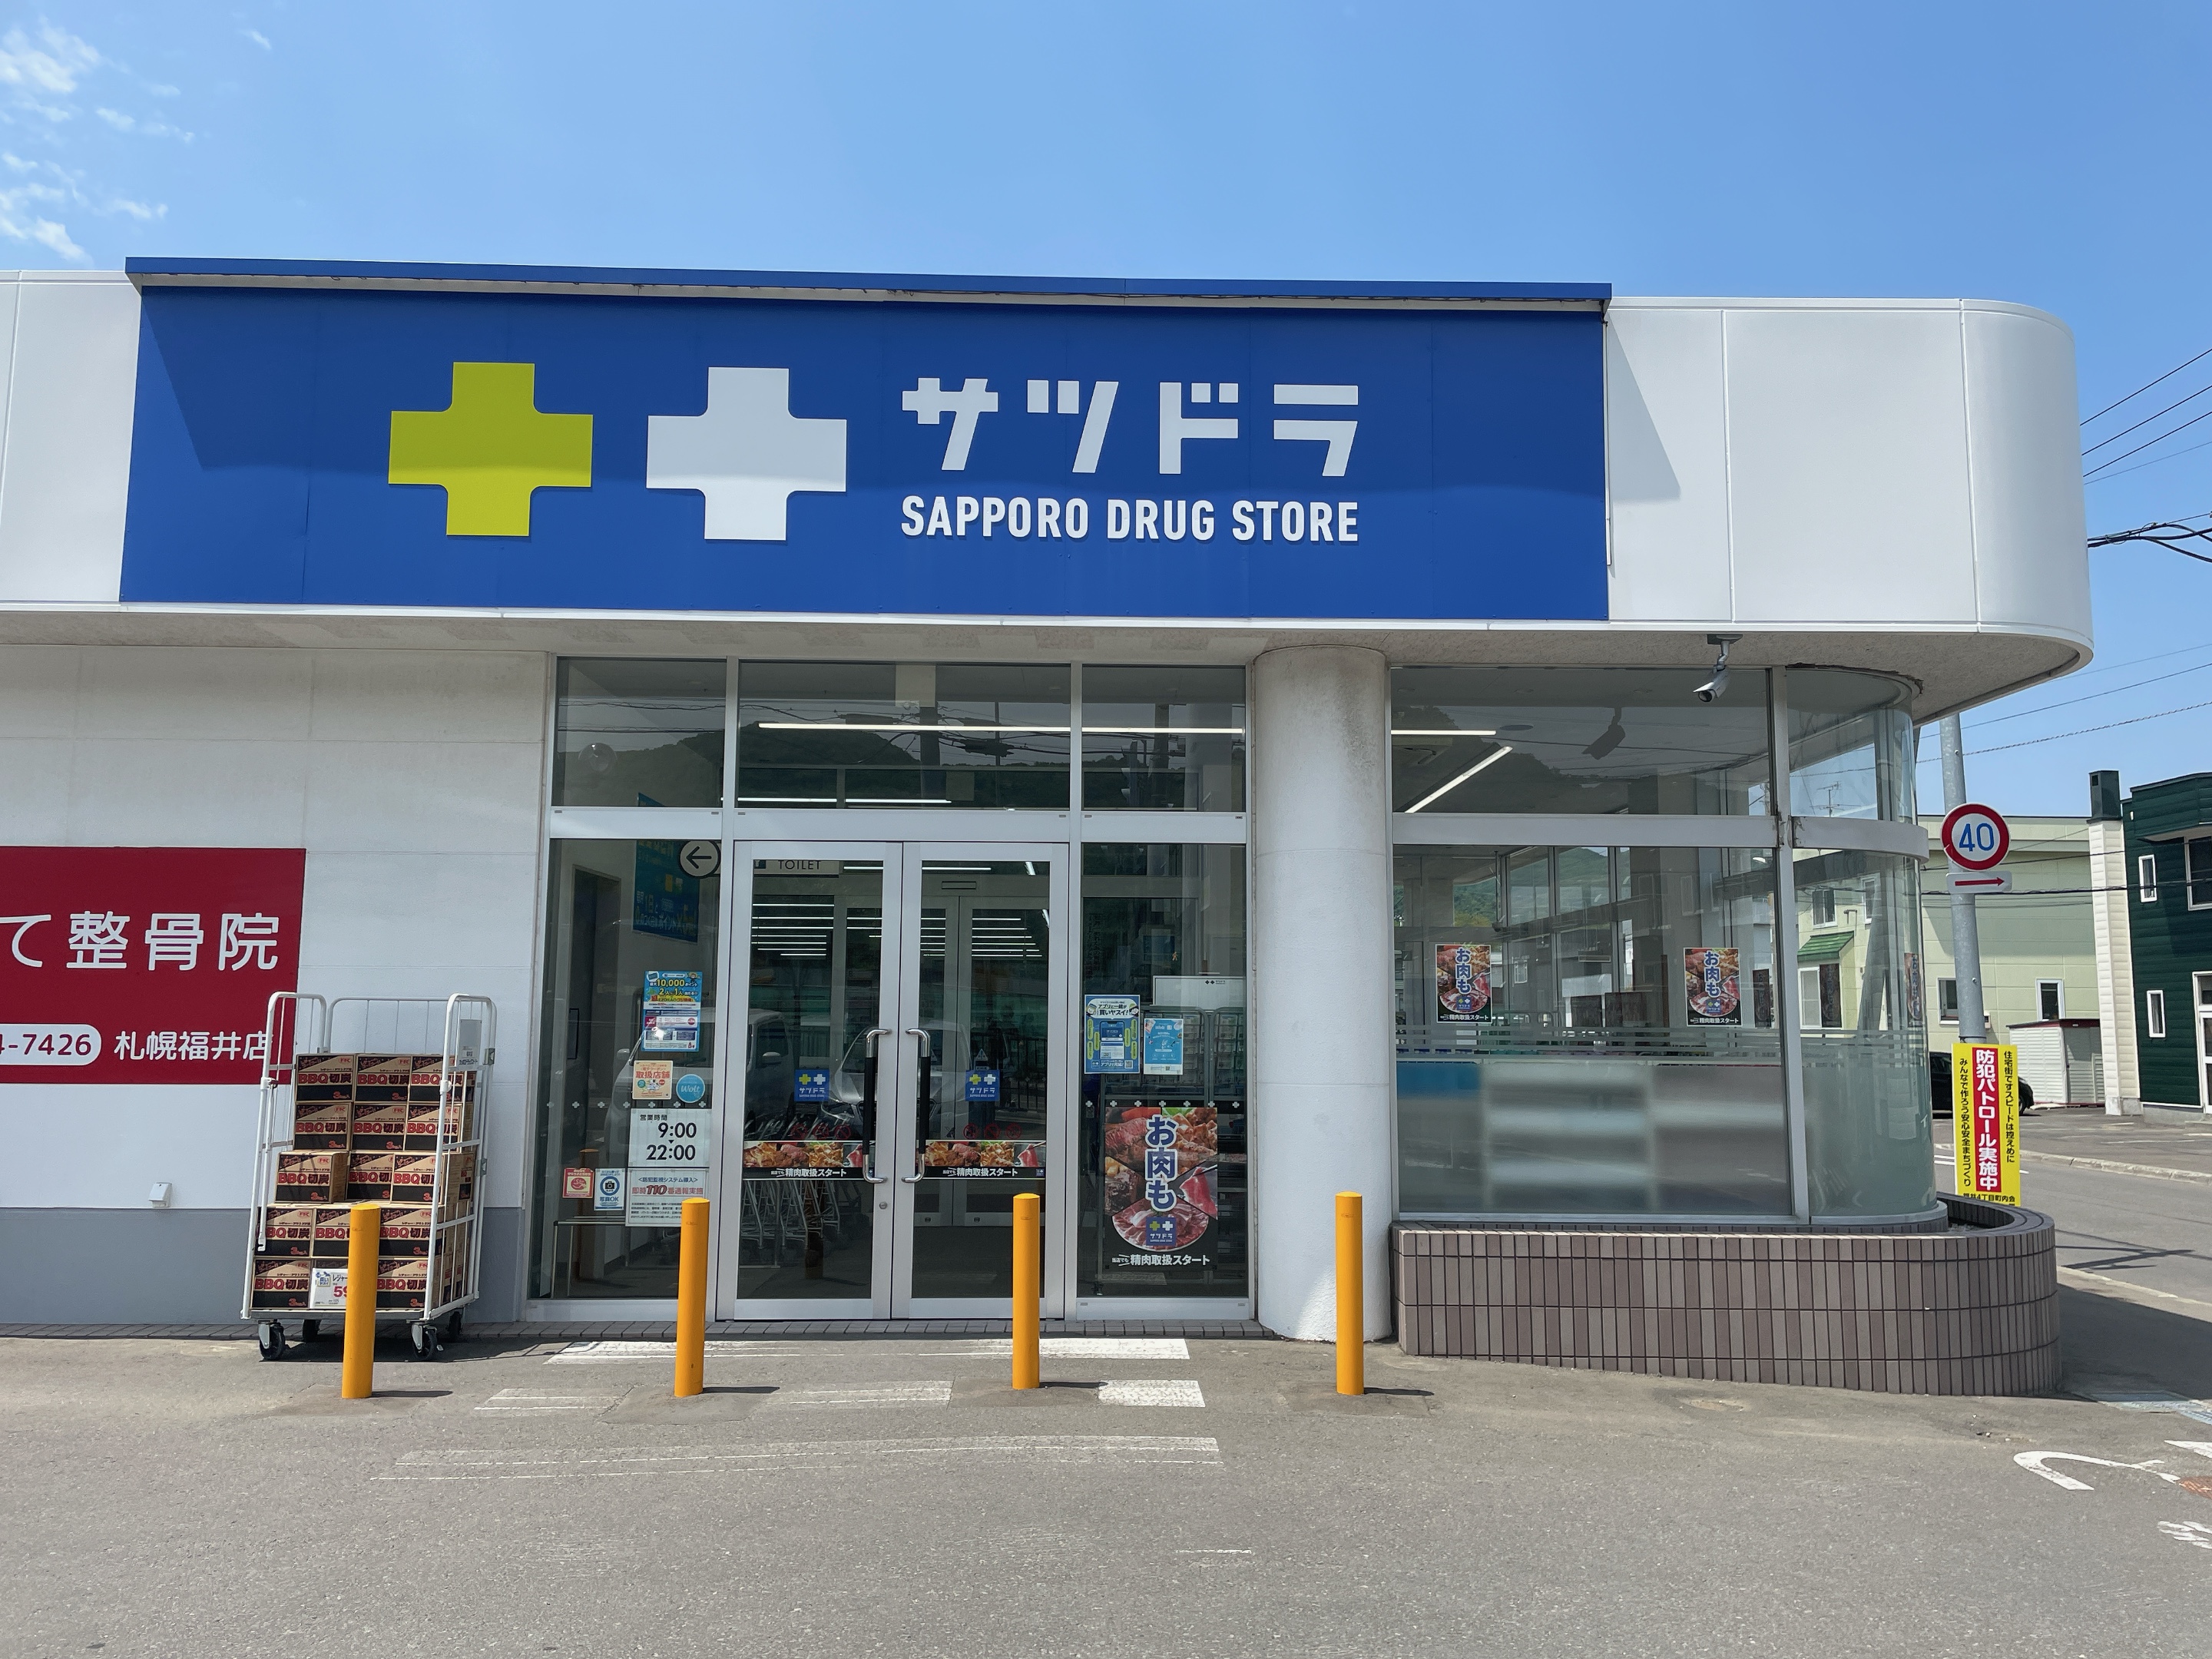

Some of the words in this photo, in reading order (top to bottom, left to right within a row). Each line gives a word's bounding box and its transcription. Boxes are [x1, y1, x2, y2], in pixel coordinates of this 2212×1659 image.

[902, 377, 1359, 477] サツドラ
[901, 495, 1089, 539] SAPPORO
[1107, 498, 1215, 541] DRUG
[1231, 499, 1359, 542] STORE
[1959, 823, 1995, 852] 40
[778, 860, 822, 869] TOILET
[1455, 947, 1472, 995] お肉も
[1704, 950, 1720, 998] お肉も
[0, 1034, 91, 1056] -7426
[114, 1031, 267, 1061] 札幌福井店
[635, 1071, 671, 1079] 取扱店舗
[680, 1084, 701, 1094] Wolt
[2004, 1051, 2015, 1164] 住宅街ですスピードは控えめに
[1959, 1058, 1972, 1187] みんなで作ろう安心安全まちづくり
[1975, 1049, 1998, 1191] 防犯パトロール実施中
[657, 1122, 697, 1138] 9:00
[646, 1144, 696, 1161] 22:00
[1145, 1114, 1178, 1212] お肉も
[348, 1171, 392, 1183] BBQ切
[785, 1167, 846, 1177] 精肉取扱スタート
[956, 1167, 1018, 1177] 精肉取扱スタート
[631, 1184, 704, 1195] 即時110番通報実施
[266, 1227, 310, 1239] BQ切炭
[315, 1227, 350, 1240] BBQ
[1130, 1253, 1210, 1266] 精肉取扱スタート
